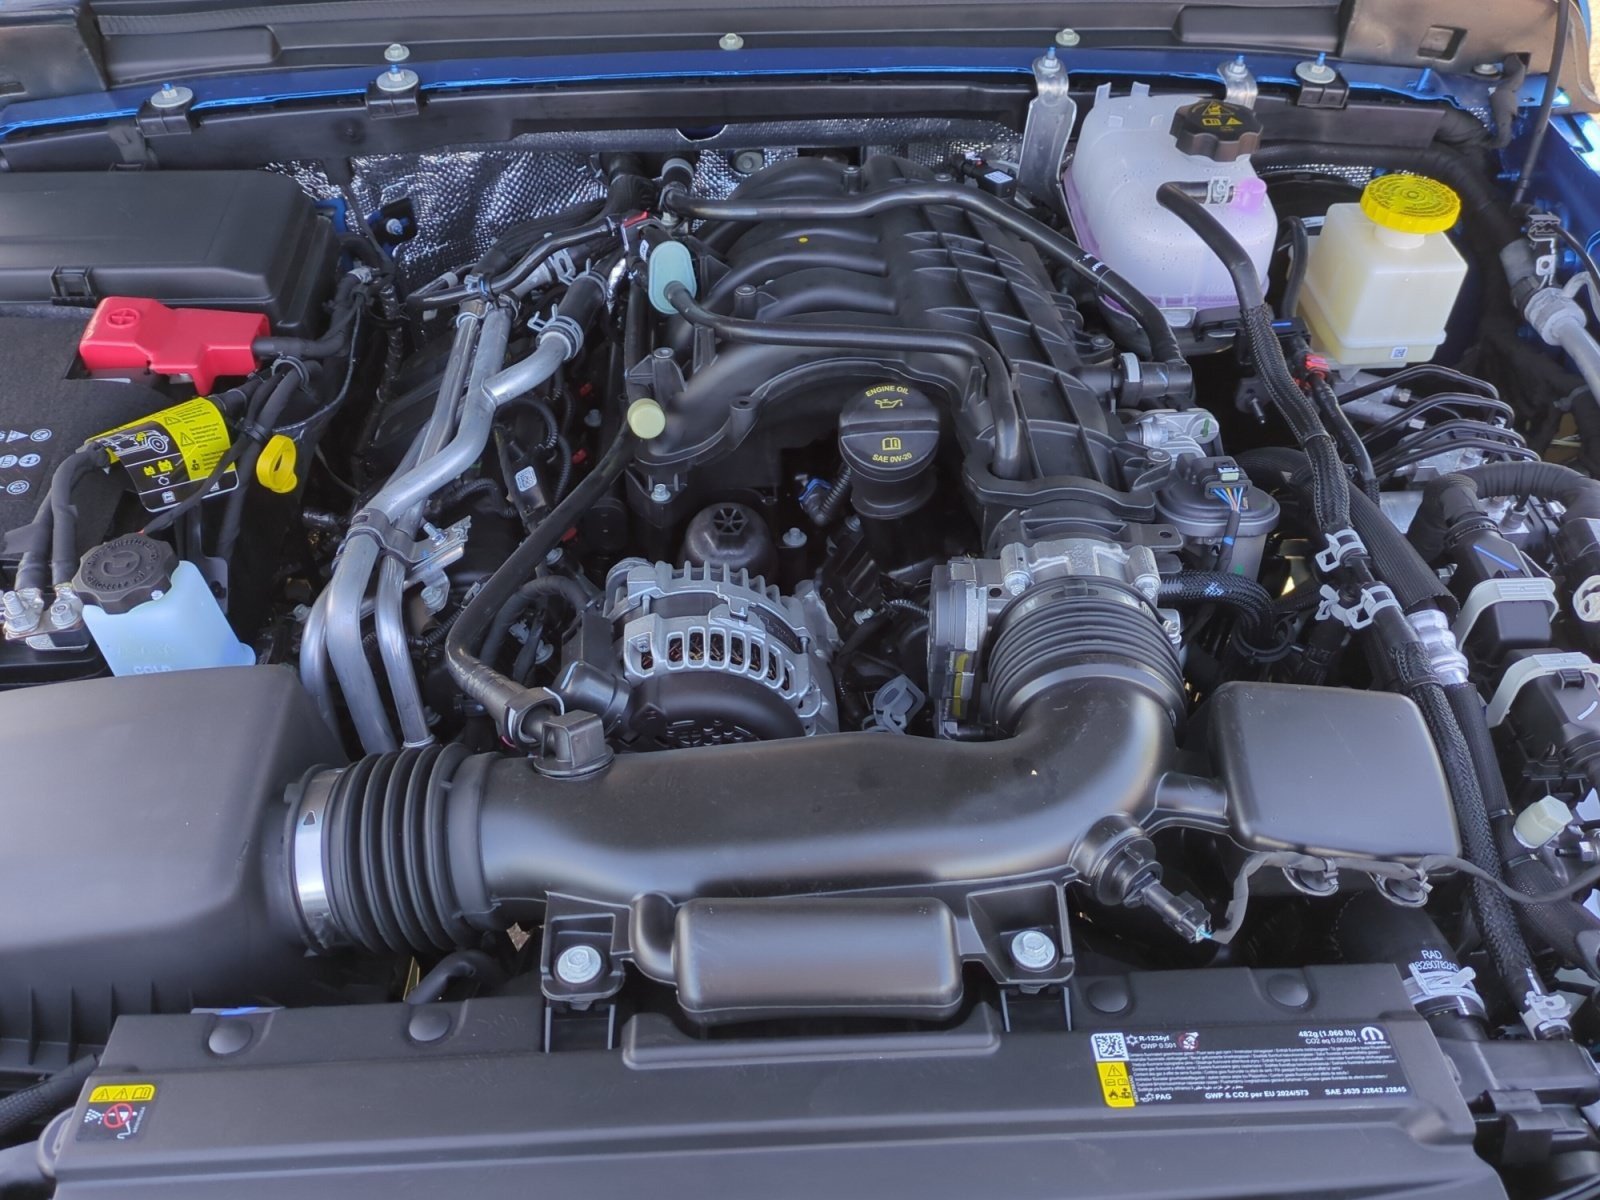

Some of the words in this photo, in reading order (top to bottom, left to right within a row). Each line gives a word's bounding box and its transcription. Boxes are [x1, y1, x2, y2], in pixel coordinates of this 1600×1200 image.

[865, 385, 895, 397] ENGINE
[896, 386, 909, 395] OIL
[872, 453, 889, 463] SAE
[890, 452, 913, 463] 0W-20
[1421, 949, 1443, 960] RAD
[1298, 1031, 1319, 1039] 482g
[1344, 1029, 1357, 1037] lb)
[1140, 1042, 1158, 1050] GWP
[1250, 1091, 1263, 1099] per
[1276, 1089, 1309, 1097] 2024/573
[1324, 1088, 1342, 1096] SAE
[1342, 1087, 1361, 1095] J639
